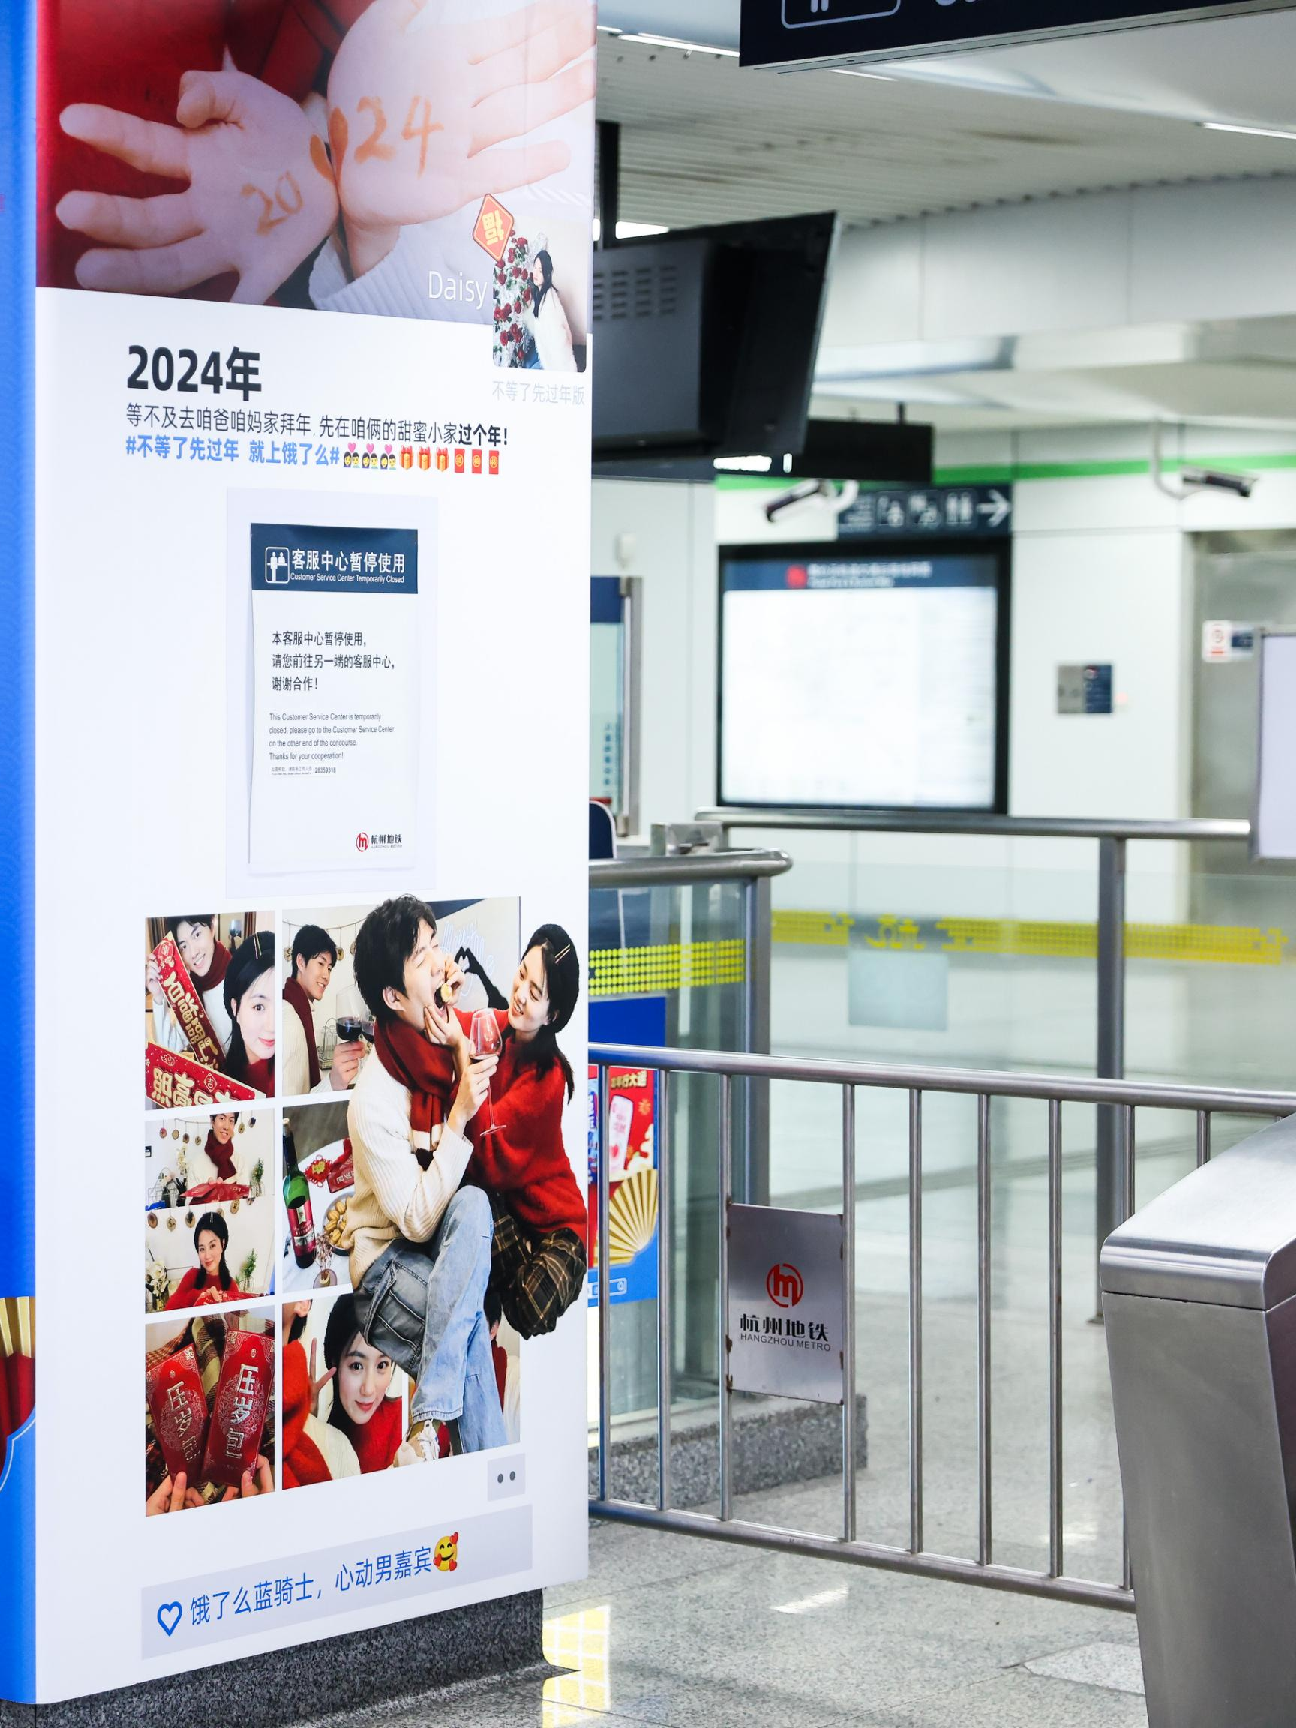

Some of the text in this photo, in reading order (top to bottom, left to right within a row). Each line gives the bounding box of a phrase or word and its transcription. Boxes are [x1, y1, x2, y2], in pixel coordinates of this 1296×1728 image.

[355, 96, 444, 178] 24
[241, 170, 304, 237] 20
[428, 271, 488, 309] Daisy
[127, 345, 262, 401] 2024年
[492, 380, 585, 406] 不等了先过年版
[126, 434, 339, 466] #不等了先过年 就上饿了么#
[292, 548, 405, 573] 客服中心暂停使用
[290, 573, 405, 584] Customer Service Center Temporarily Closed
[740, 1313, 829, 1342] 杭州地铁
[740, 1333, 831, 1352] HANGZHOU METRO
